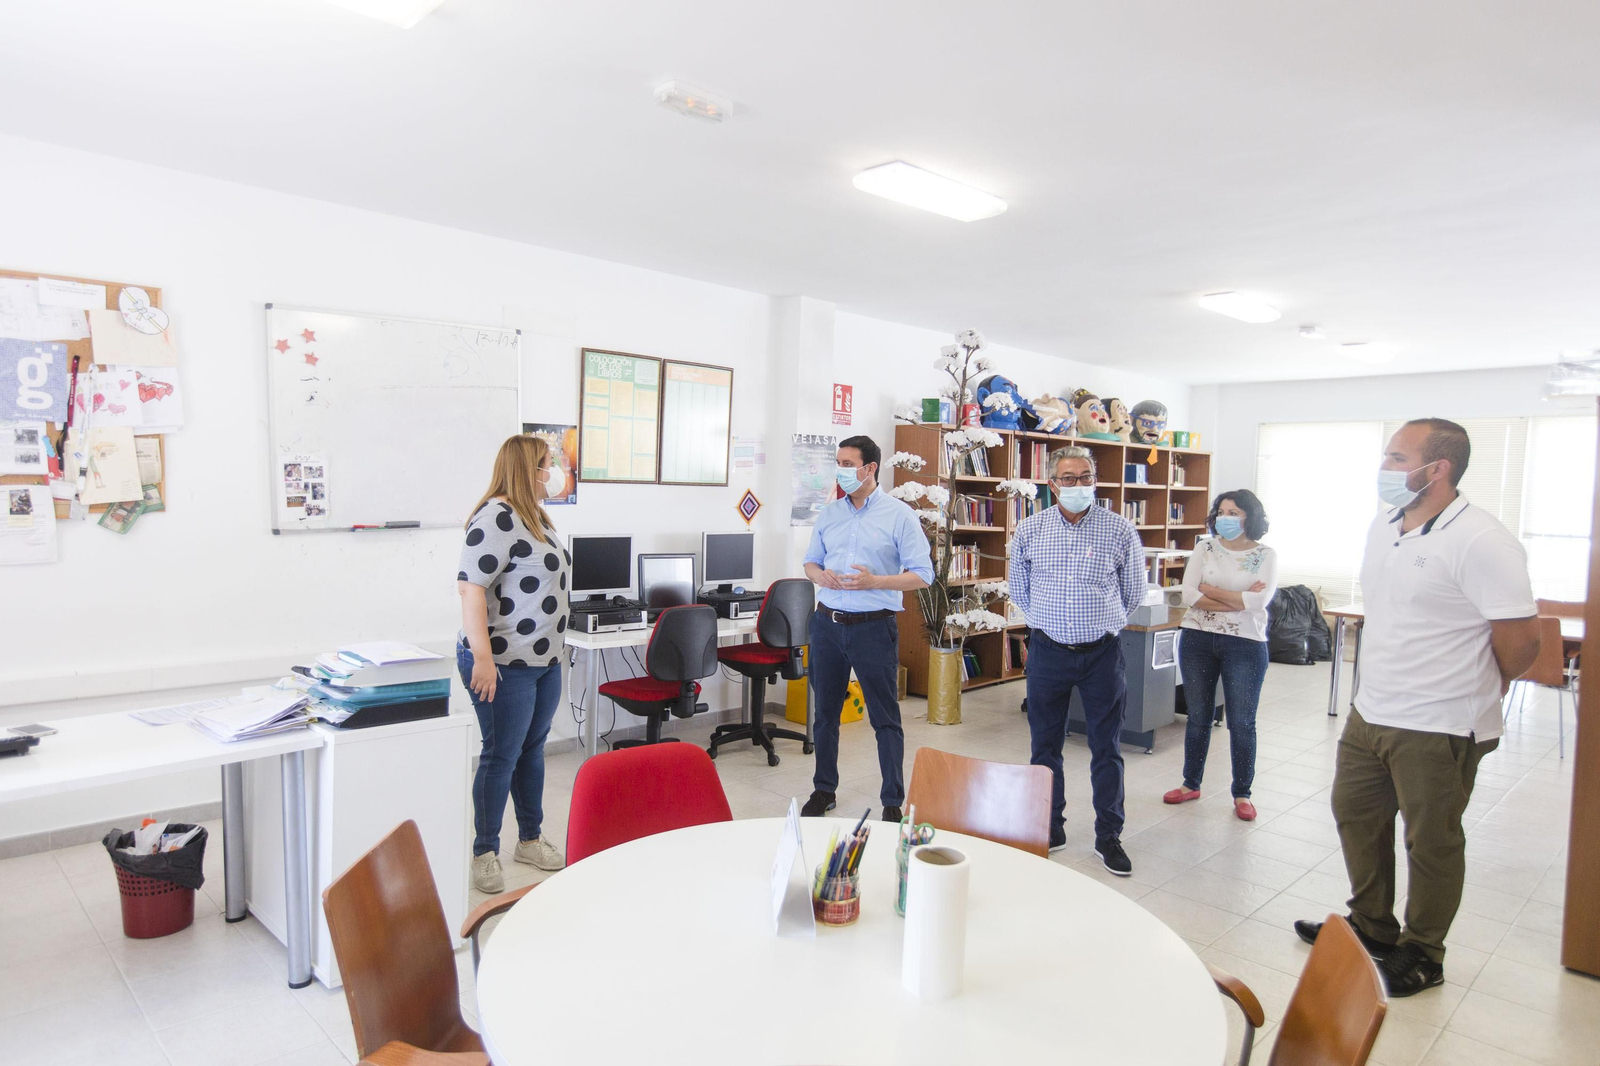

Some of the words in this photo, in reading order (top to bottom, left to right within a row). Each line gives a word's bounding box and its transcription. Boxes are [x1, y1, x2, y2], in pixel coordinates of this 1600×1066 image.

[588, 354, 632, 367] COLOCACIÓN
[598, 362, 608, 370] DE
[609, 363, 622, 372] LOS
[597, 369, 622, 379] LIBROS
[792, 434, 838, 446] VEIASA
